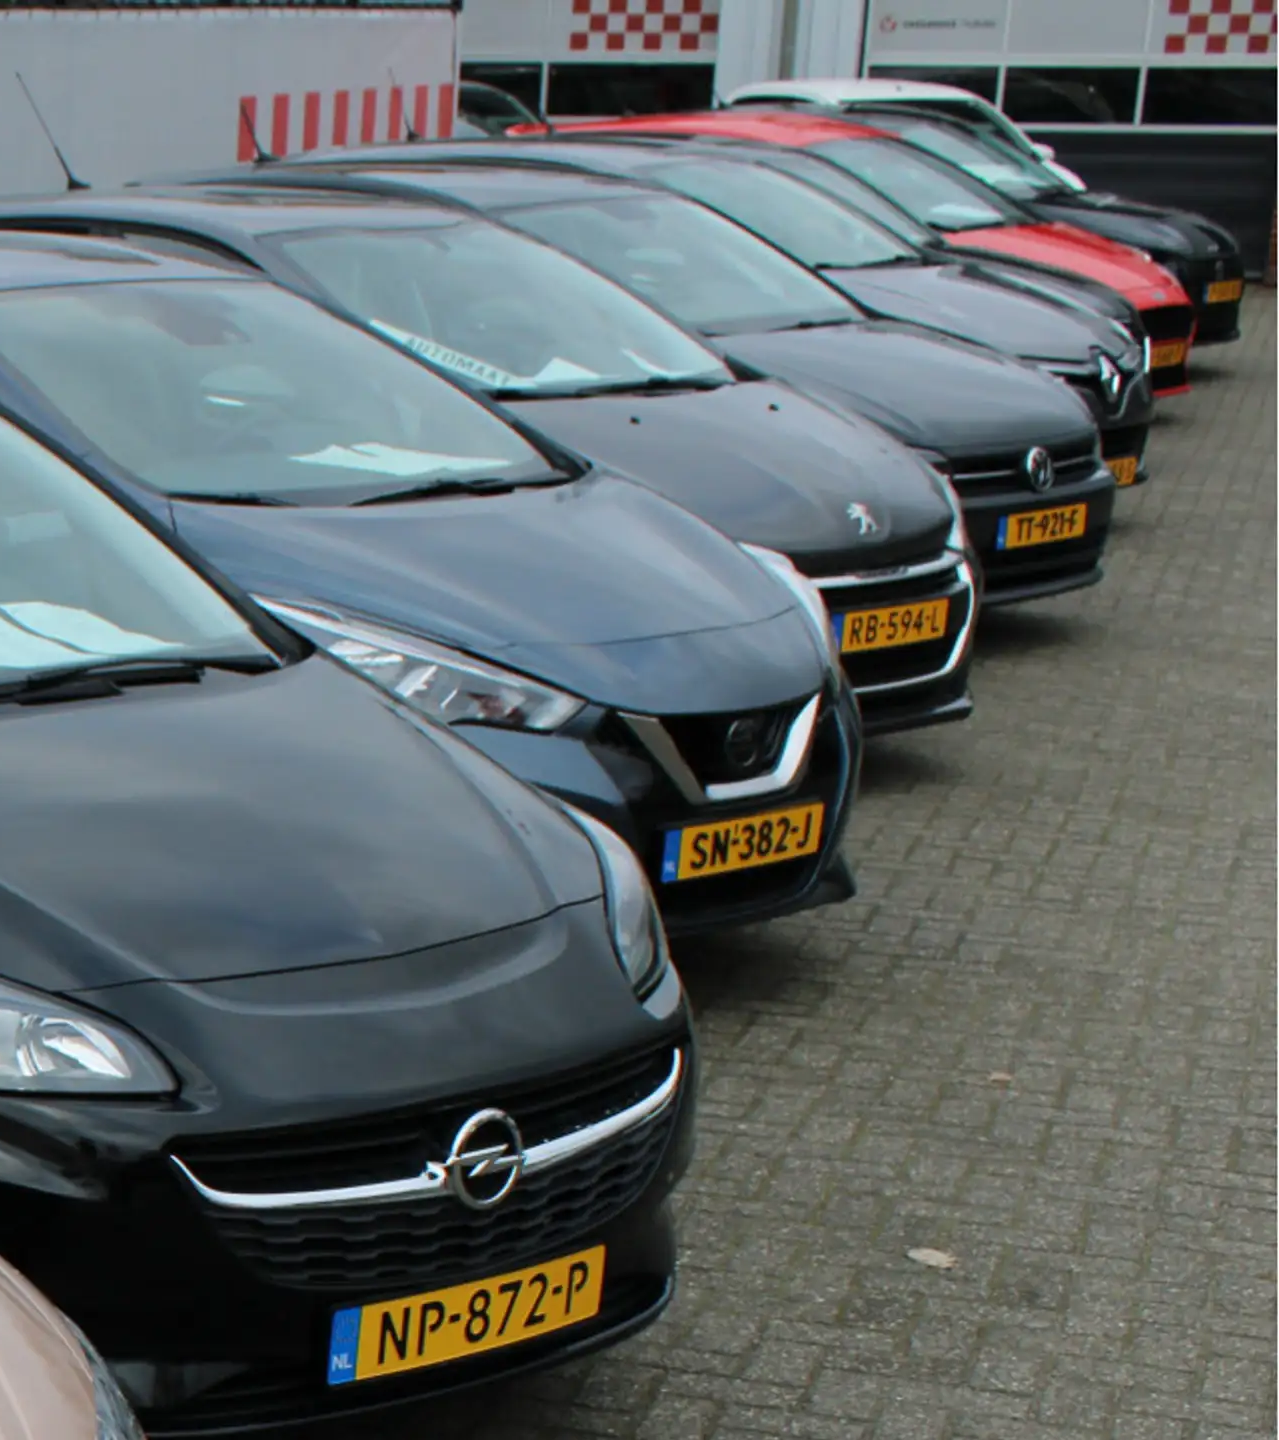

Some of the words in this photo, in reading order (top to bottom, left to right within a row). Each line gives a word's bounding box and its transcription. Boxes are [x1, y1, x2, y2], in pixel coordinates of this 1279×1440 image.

[849, 605, 940, 645] RB-594-L
[689, 811, 812, 869] SN-382-J
[376, 1260, 590, 1366] NP-872-P
[331, 1353, 354, 1370] NL
